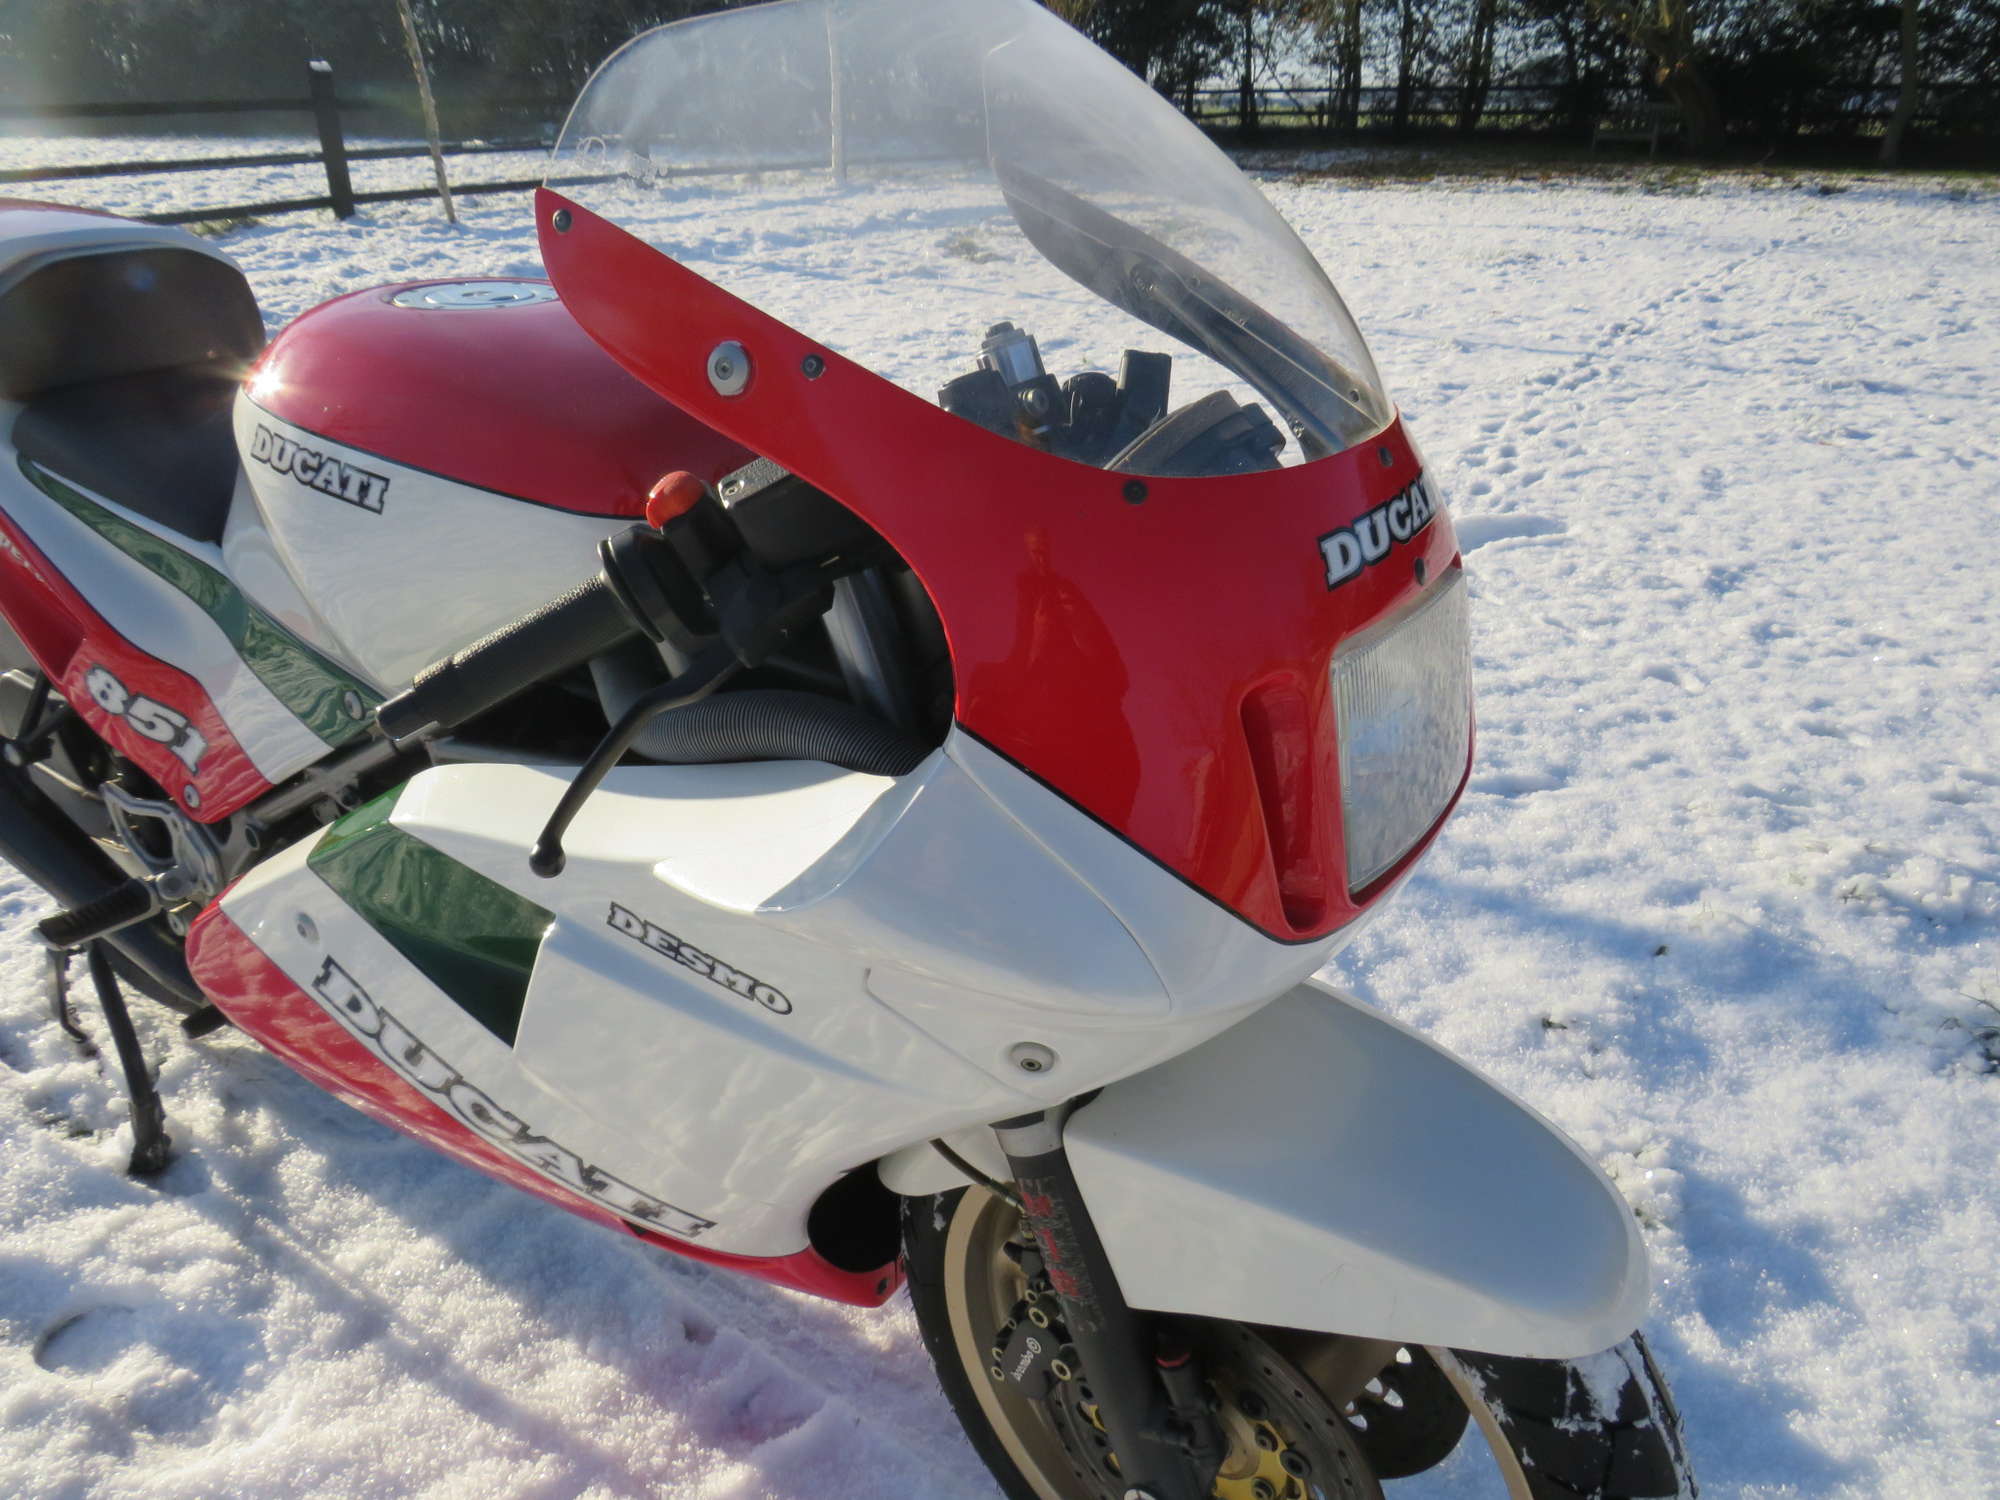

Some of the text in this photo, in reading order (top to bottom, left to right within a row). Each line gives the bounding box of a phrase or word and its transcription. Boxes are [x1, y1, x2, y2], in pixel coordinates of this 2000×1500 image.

[251, 423, 390, 515] DUCATI
[84, 663, 208, 777] 851
[607, 901, 792, 1016] DESMO
[312, 955, 718, 1238] DUCATI
